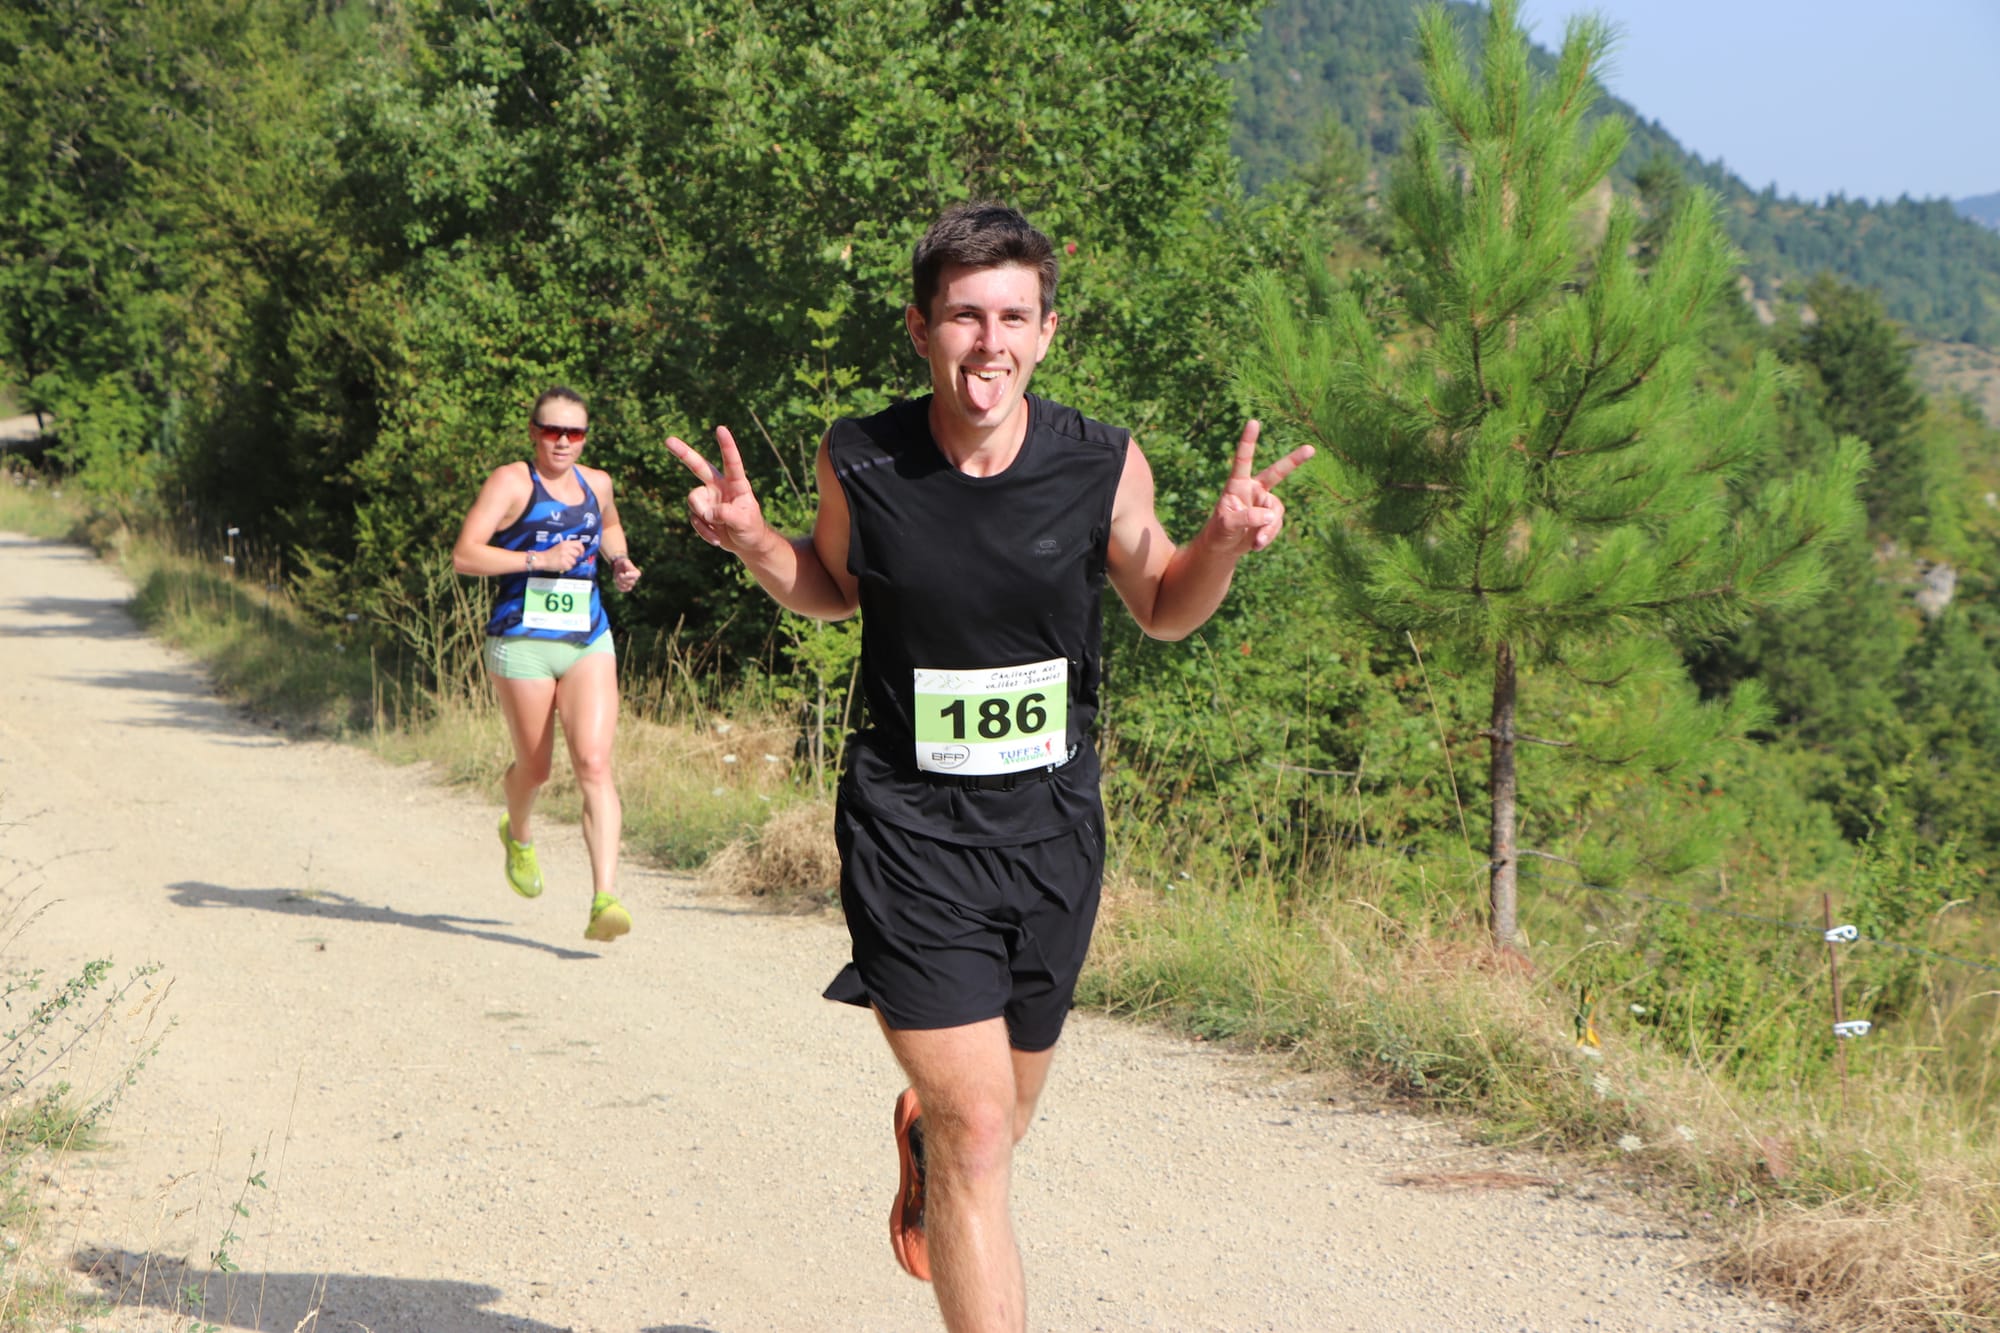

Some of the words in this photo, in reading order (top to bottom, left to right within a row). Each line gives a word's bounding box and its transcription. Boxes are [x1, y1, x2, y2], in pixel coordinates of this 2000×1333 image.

[545, 593, 573, 612] 69
[941, 693, 1047, 739] 186
[932, 752, 964, 761] BFP
[999, 745, 1040, 759] TUFF'S
